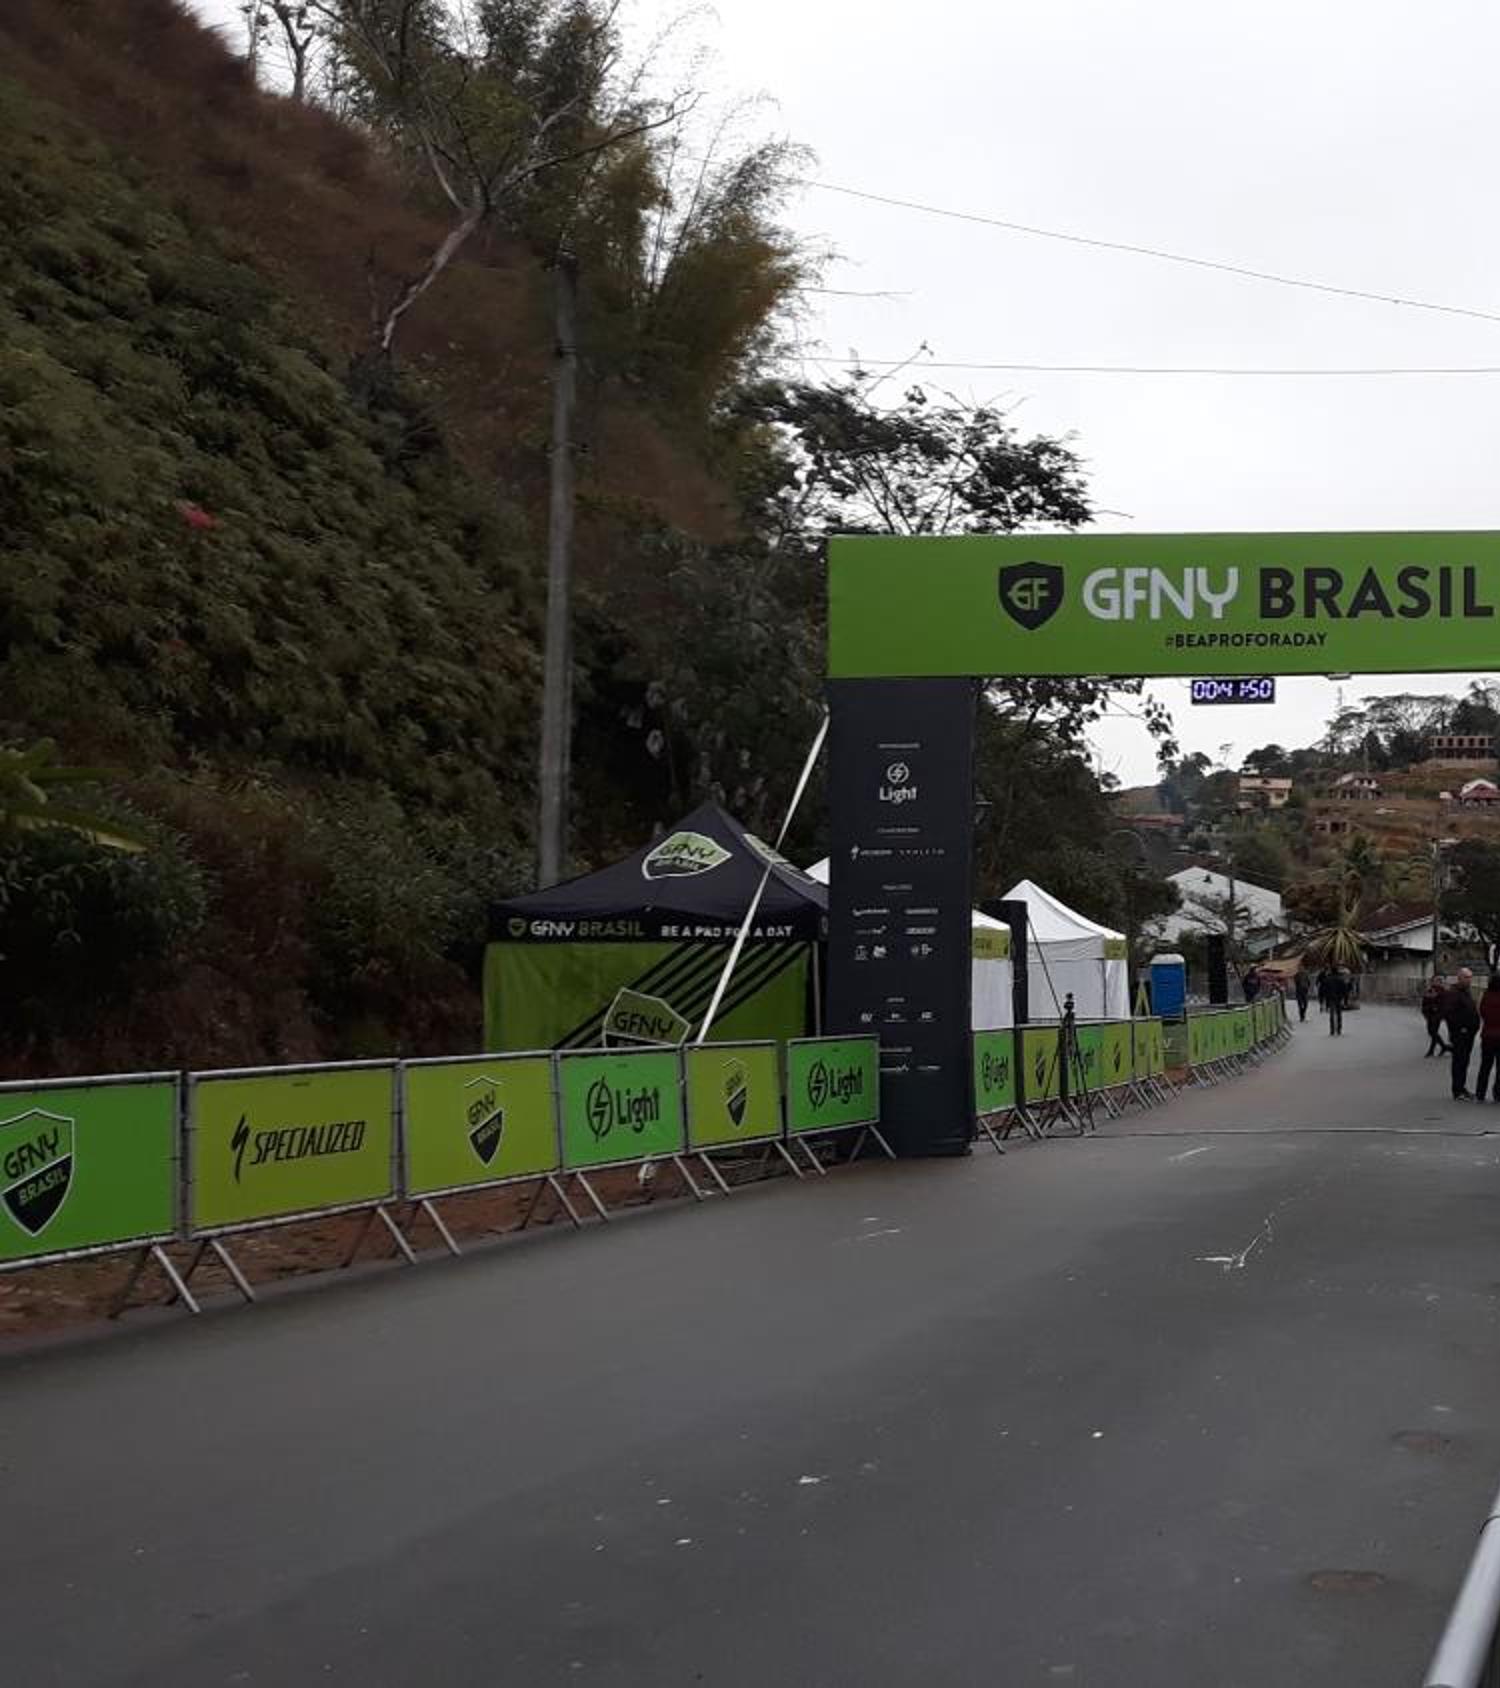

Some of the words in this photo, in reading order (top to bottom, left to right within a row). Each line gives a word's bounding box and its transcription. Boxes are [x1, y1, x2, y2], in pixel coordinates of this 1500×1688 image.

[1007, 577, 1050, 611] GF
[1082, 566, 1239, 621] GFNY
[1259, 565, 1495, 619] BRASIL
[1165, 632, 1328, 649] #BEAPROFORADAY
[879, 786, 918, 805] Light
[530, 919, 575, 937] GFNY
[614, 1010, 674, 1038] GFNY
[829, 1064, 863, 1104] Light
[616, 1086, 660, 1133] Light
[4, 1126, 59, 1179] GFNY
[250, 1120, 366, 1166] SPECIALIZED
